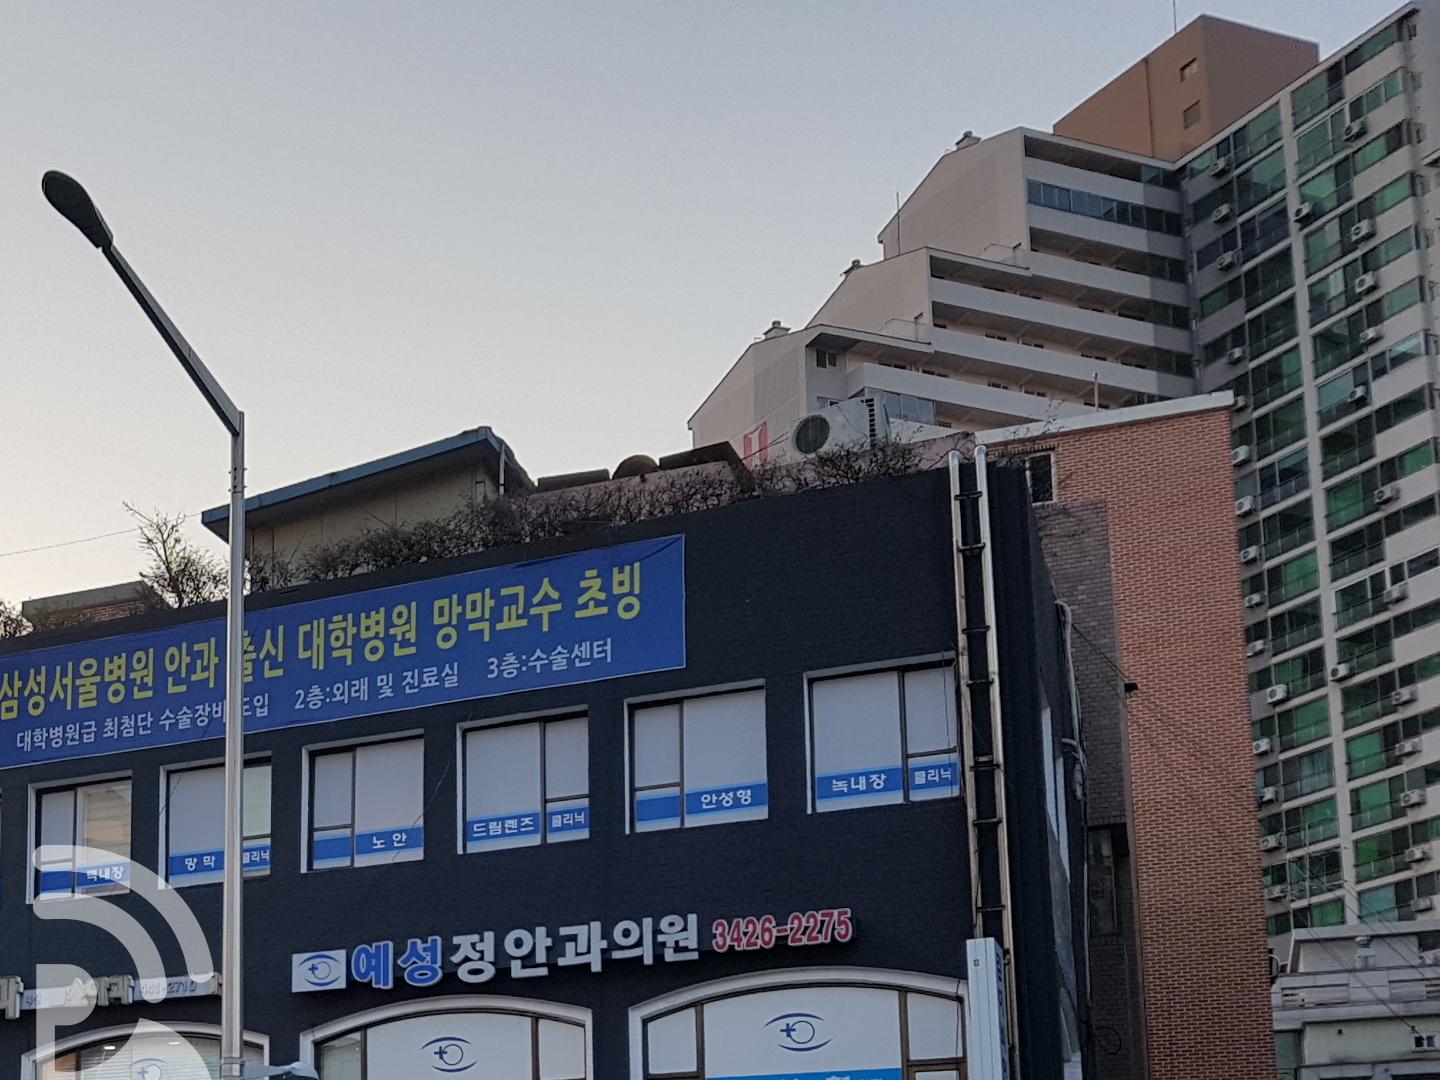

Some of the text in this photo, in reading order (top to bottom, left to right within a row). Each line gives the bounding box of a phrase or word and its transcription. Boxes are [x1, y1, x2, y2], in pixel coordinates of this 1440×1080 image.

[164, 637, 219, 694] 안과
[297, 600, 417, 671] 대학병원
[433, 577, 563, 650] 망막교수
[575, 562, 641, 620] 초빙
[16, 719, 97, 753] 대학병원급
[103, 711, 153, 740] 최첨단
[159, 700, 227, 732] 수술장비
[295, 677, 368, 710] 2층:외래
[377, 672, 394, 699] 및
[402, 662, 459, 695] 진료실
[487, 636, 613, 680] 3층:수술센터
[700, 788, 753, 810] 안성형
[830, 772, 887, 794] 녹내장
[472, 816, 535, 838] 드림렌즈
[713, 908, 852, 953] 3426-2275
